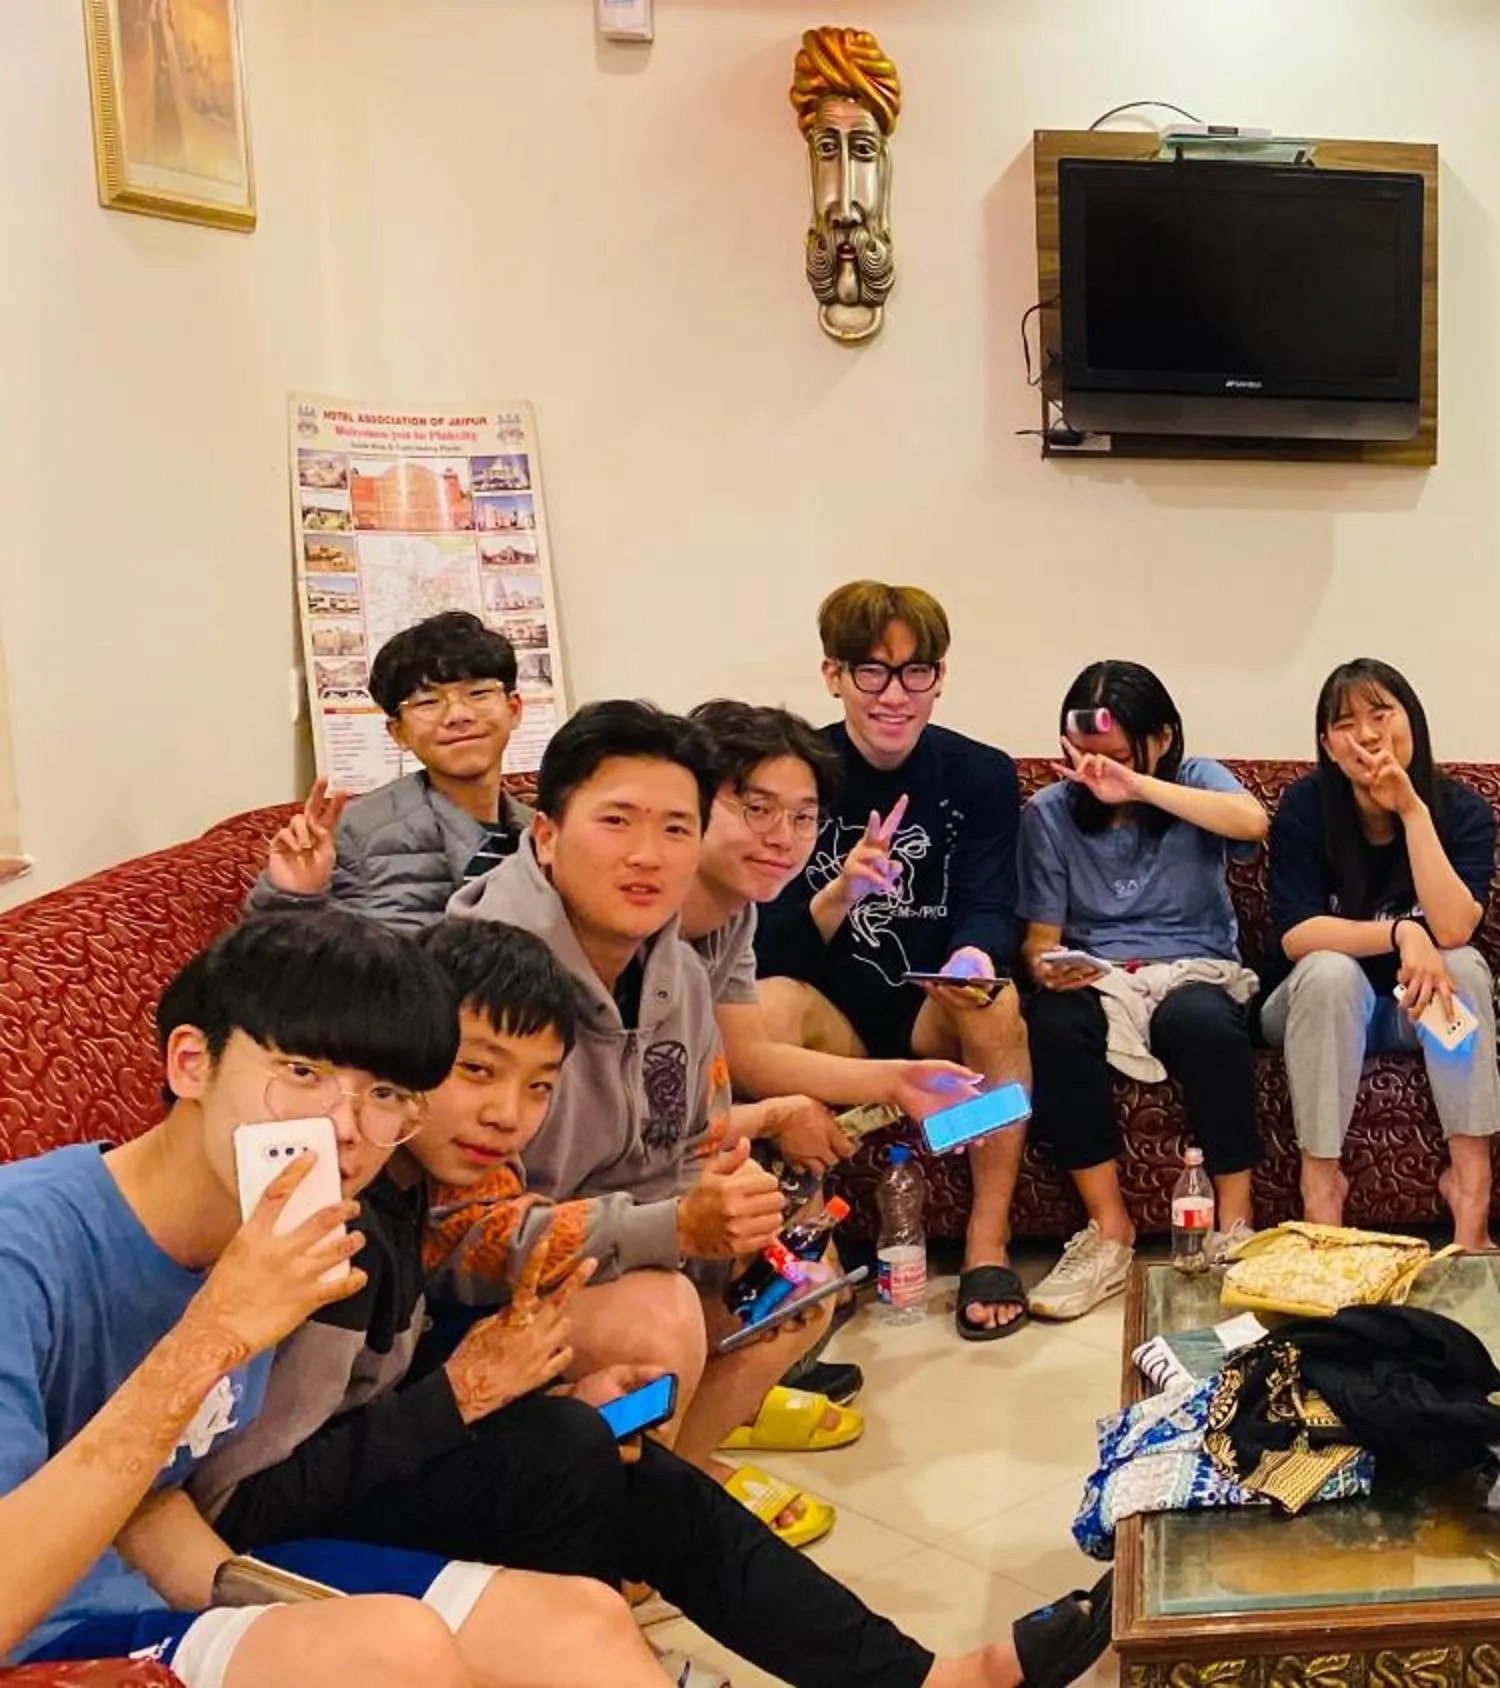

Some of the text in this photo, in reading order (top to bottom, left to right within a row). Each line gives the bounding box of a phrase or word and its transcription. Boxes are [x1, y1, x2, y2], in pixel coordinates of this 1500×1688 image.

[323, 410, 488, 427] HOTEL ASSOCIATION OF JAIPUR
